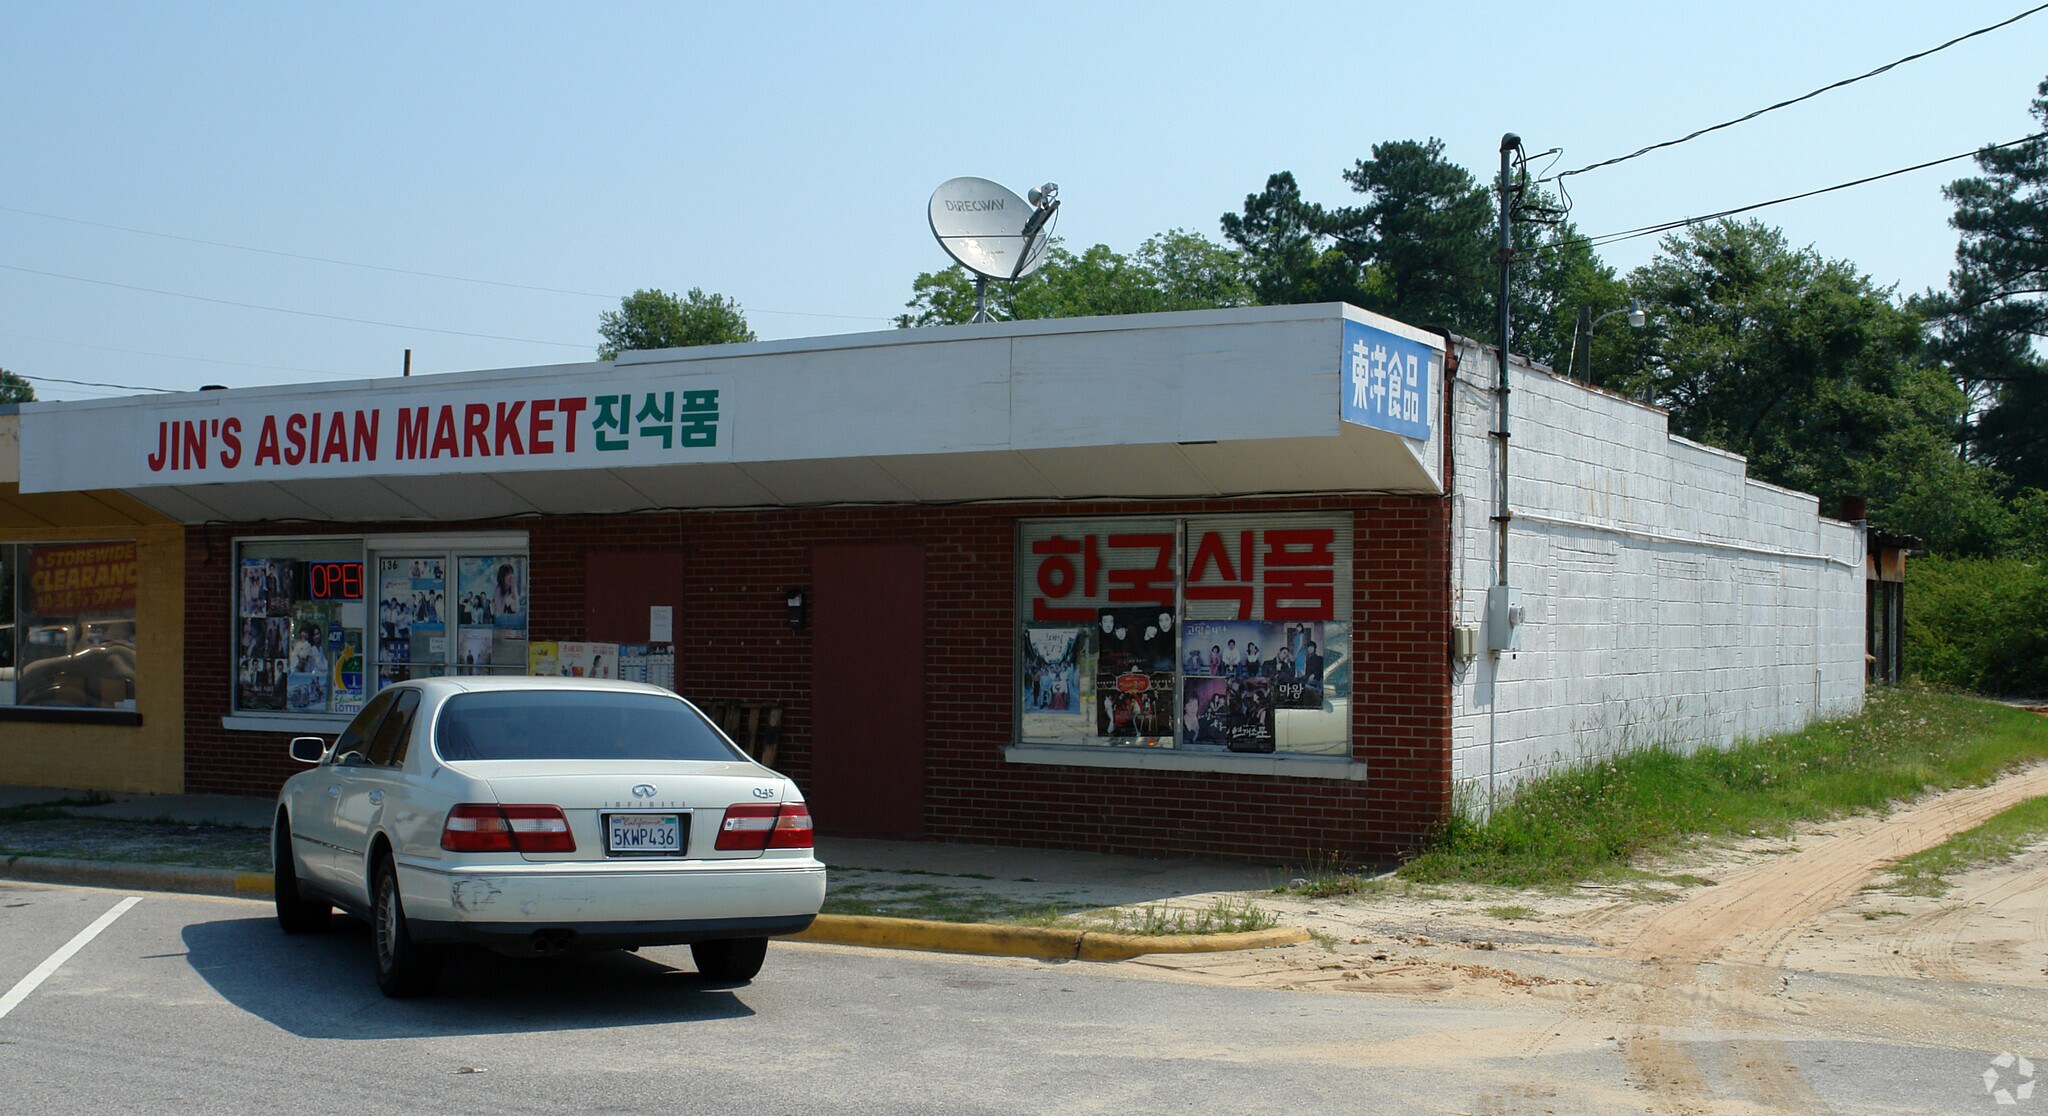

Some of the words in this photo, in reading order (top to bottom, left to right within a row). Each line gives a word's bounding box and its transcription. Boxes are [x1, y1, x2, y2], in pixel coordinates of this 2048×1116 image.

[1352, 339, 1419, 423] 東洋食品
[592, 389, 720, 452] 진식품
[148, 417, 242, 472] JIN'S
[254, 409, 380, 466] ASIAN
[395, 397, 588, 461] MARKET
[47, 544, 133, 567] STOREWIDE
[382, 560, 398, 570] 136
[1032, 529, 1334, 622] 한국식품
[328, 631, 342, 642] ADT
[1279, 683, 1304, 699] 마왕
[753, 787, 774, 799] Q45
[623, 816, 663, 828] California
[614, 828, 674, 846] 5KWP436
